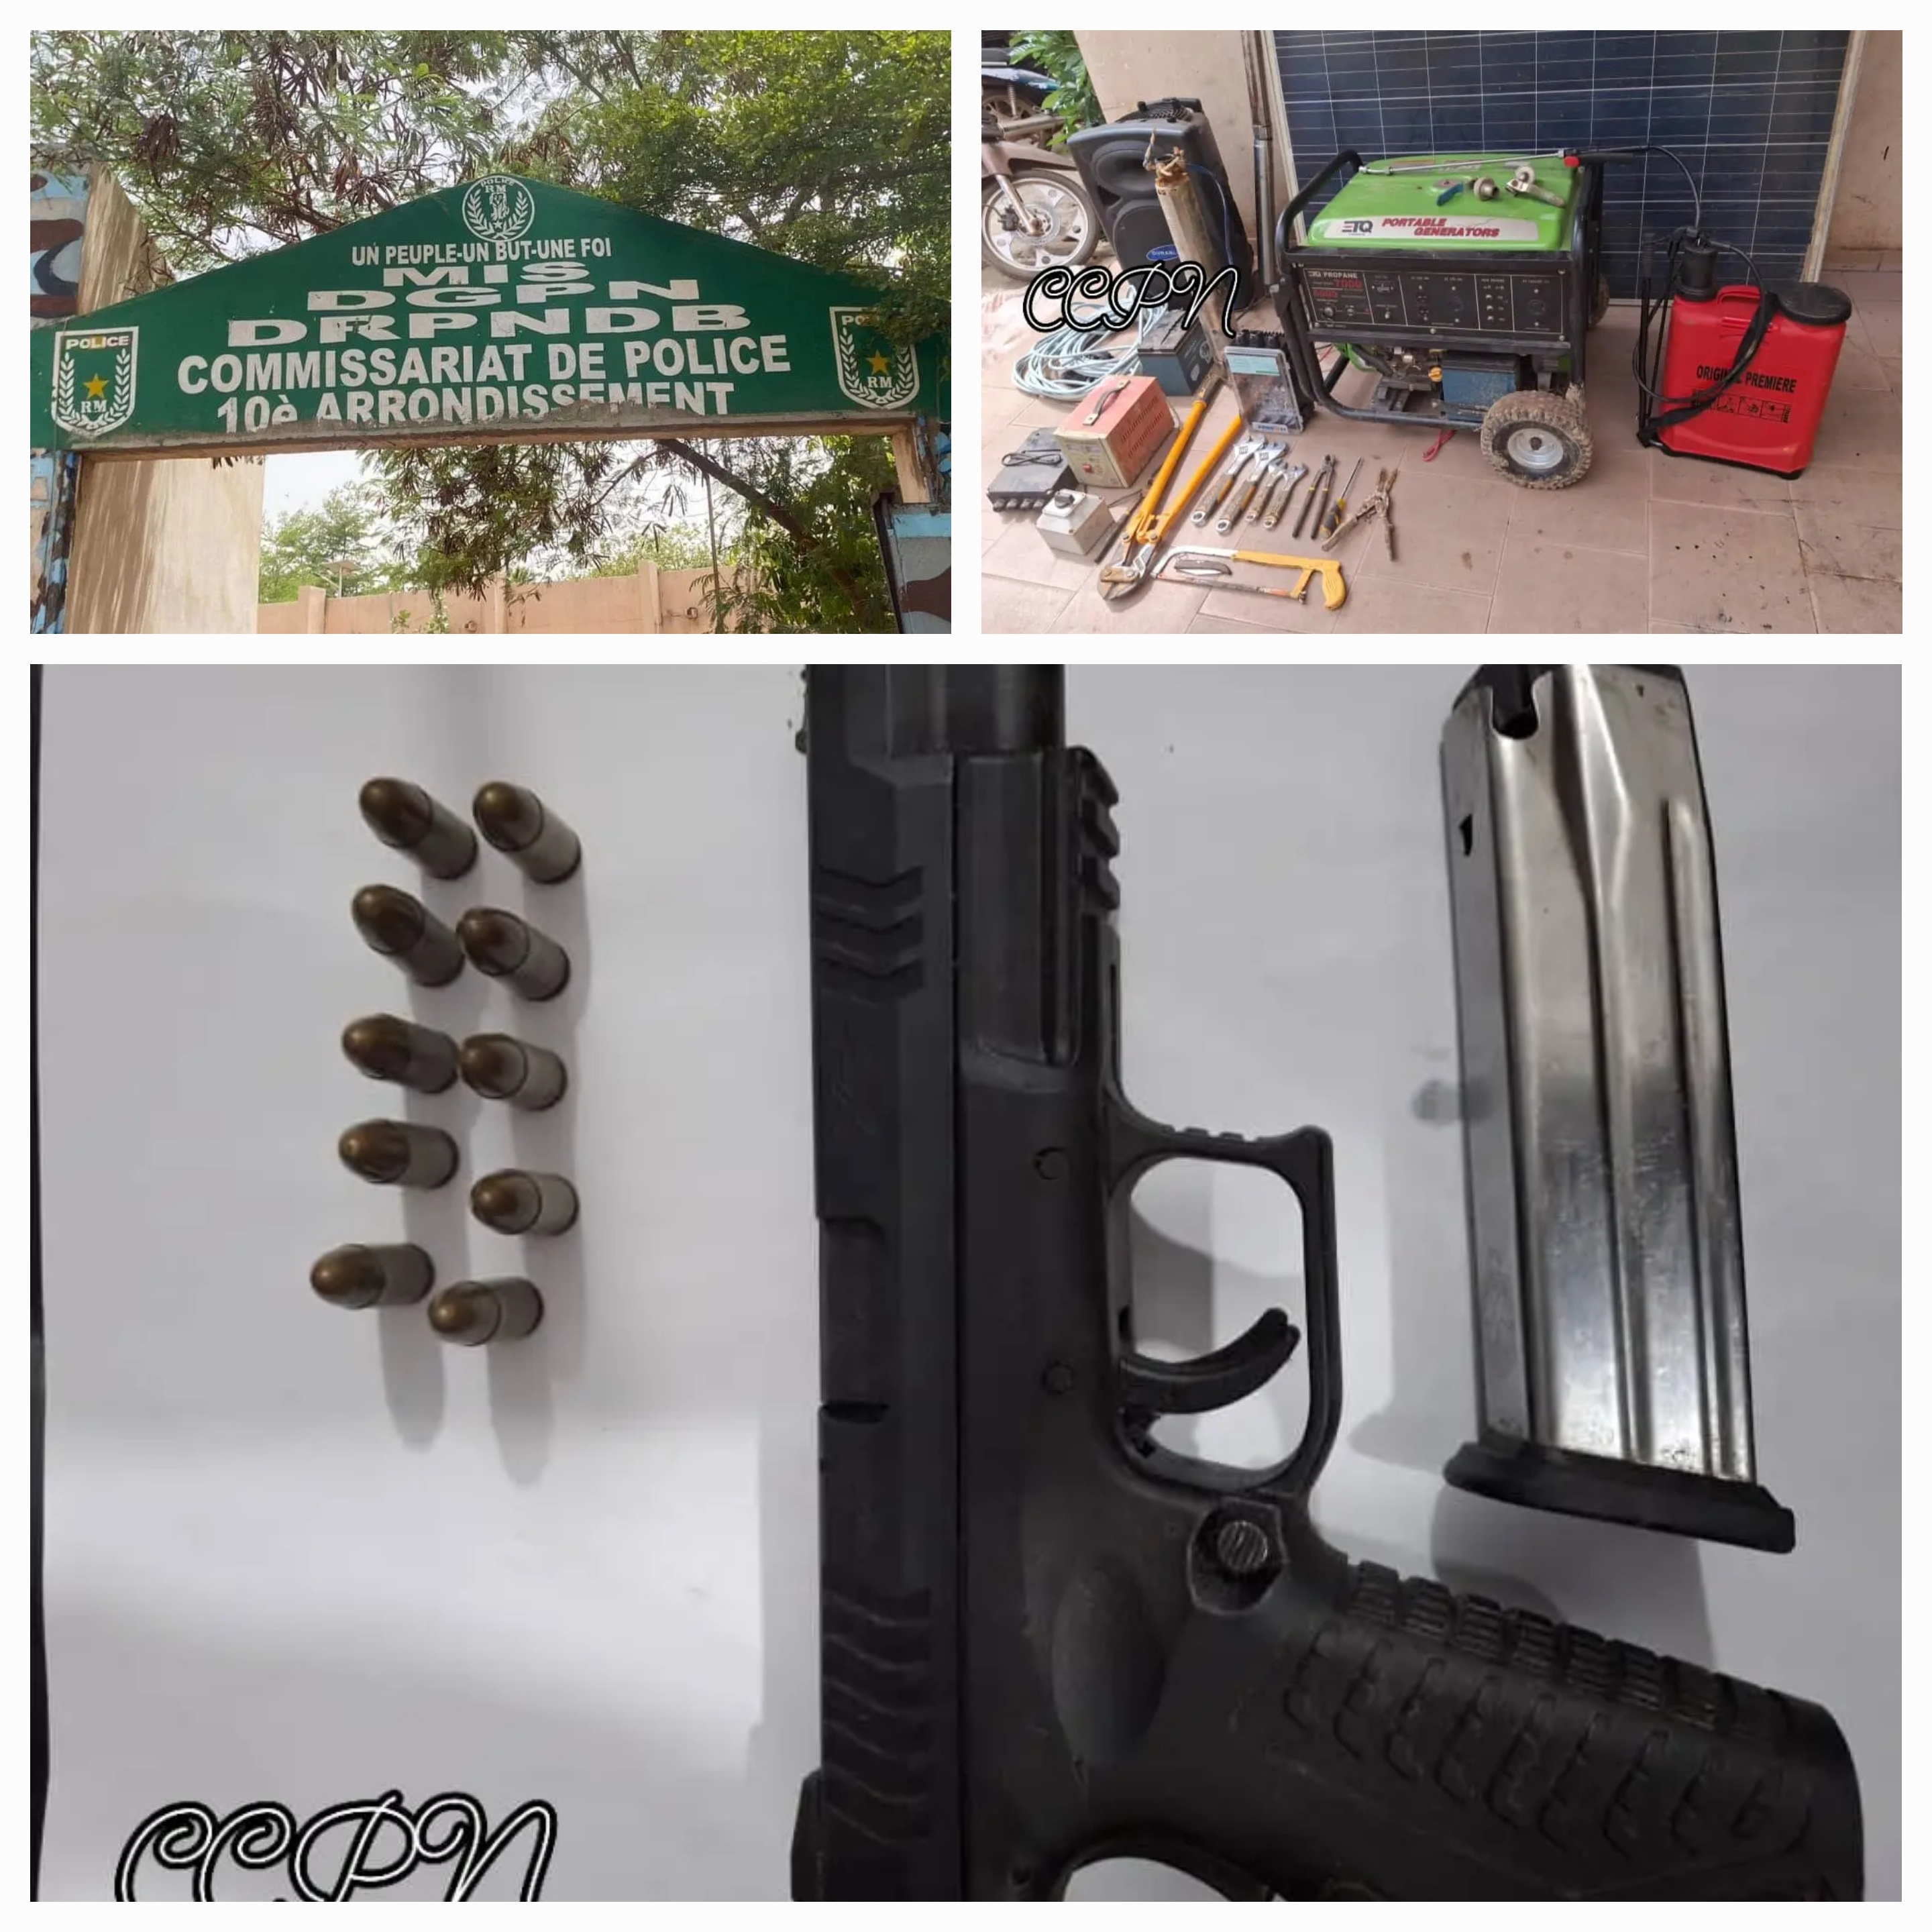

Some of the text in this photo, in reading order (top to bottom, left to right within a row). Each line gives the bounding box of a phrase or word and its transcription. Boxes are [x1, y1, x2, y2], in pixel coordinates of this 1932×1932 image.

[485, 184, 506, 193] RM
[1342, 220, 1373, 233] ETQ
[1382, 218, 1448, 227] PORTABLE
[1413, 227, 1500, 237] GENERATORS
[352, 237, 612, 266] UN PEUPLE-UN BUT-UNE FOI
[383, 262, 590, 287] MIS
[307, 279, 700, 311] DGPN
[228, 305, 751, 347] DRPNDB
[66, 336, 130, 350] POLICE
[178, 334, 791, 394] COMMISSARIAT DE POLICE
[867, 376, 892, 388] RM
[1696, 365, 1797, 393] ORIGIL PREMIERE
[80, 400, 107, 413] RM
[217, 382, 735, 434] 10è ARRONDISSEMENT
